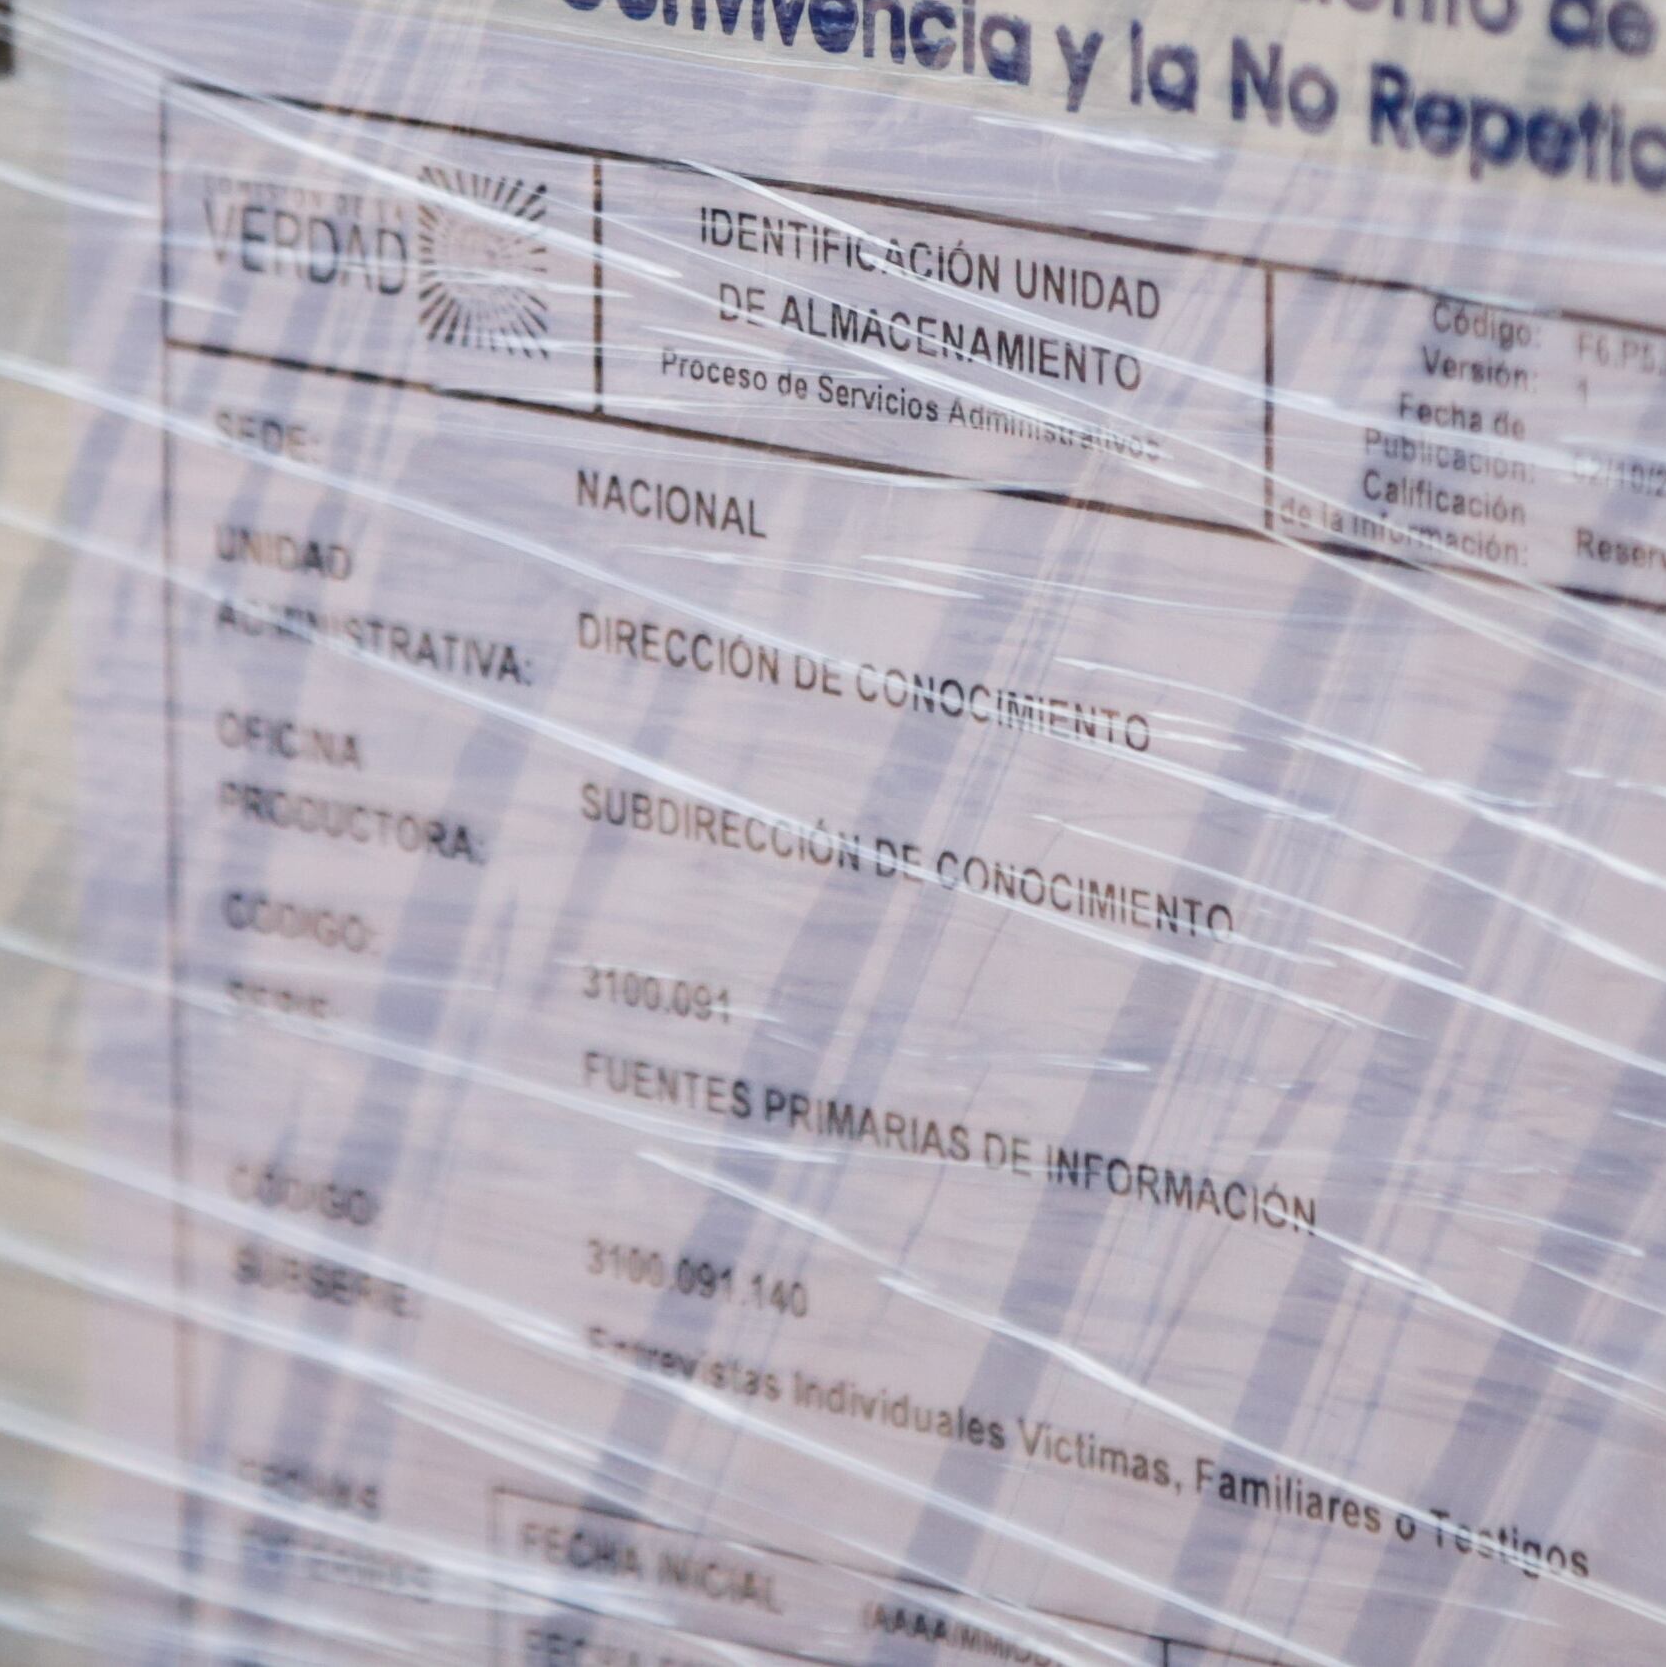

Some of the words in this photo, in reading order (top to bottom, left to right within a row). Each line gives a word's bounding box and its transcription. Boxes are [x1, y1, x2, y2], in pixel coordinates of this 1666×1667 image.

[1054, 21, 1104, 114] y
[1124, 19, 1201, 112] la
[1230, 35, 1335, 138] No
[203, 196, 409, 297] VERDAD
[698, 204, 1001, 292] IDENTIFICACIÓN
[1015, 244, 1163, 321] UNIDAD
[718, 281, 767, 329] DE
[779, 294, 1145, 394] ALMACENAMIENTO
[1432, 299, 1541, 352] Código:
[661, 346, 769, 392] Proceso
[777, 369, 808, 402] de
[817, 374, 940, 424] Servicios
[1421, 344, 1539, 394] Versión:
[1398, 390, 1483, 433] Fecha
[1493, 411, 1526, 441] de
[576, 468, 769, 539] NACIONAL
[1361, 467, 1527, 527] Calificación
[216, 523, 353, 583] UNIDAD
[577, 610, 781, 686] DIRECCIÓN
[793, 652, 843, 699] DE
[854, 662, 1152, 754] CONOCIMIENTO
[216, 709, 363, 771] OFICINA
[216, 780, 488, 866] PRODUCTORA:
[580, 782, 861, 874] SUBDIRECCIÓN
[874, 836, 923, 883] DE
[935, 851, 1235, 944] CONOCIMIENTO
[580, 964, 733, 1024] 3100.091
[583, 1050, 752, 1121] FUENTES
[763, 1092, 970, 1165] PRIMARIAS
[983, 1132, 1034, 1181] DE
[1047, 1146, 1319, 1237] INFORMACIÓN
[792, 1370, 1007, 1452] Individuales
[1195, 1454, 1382, 1536] Familiares
[1394, 1512, 1417, 1542] o
